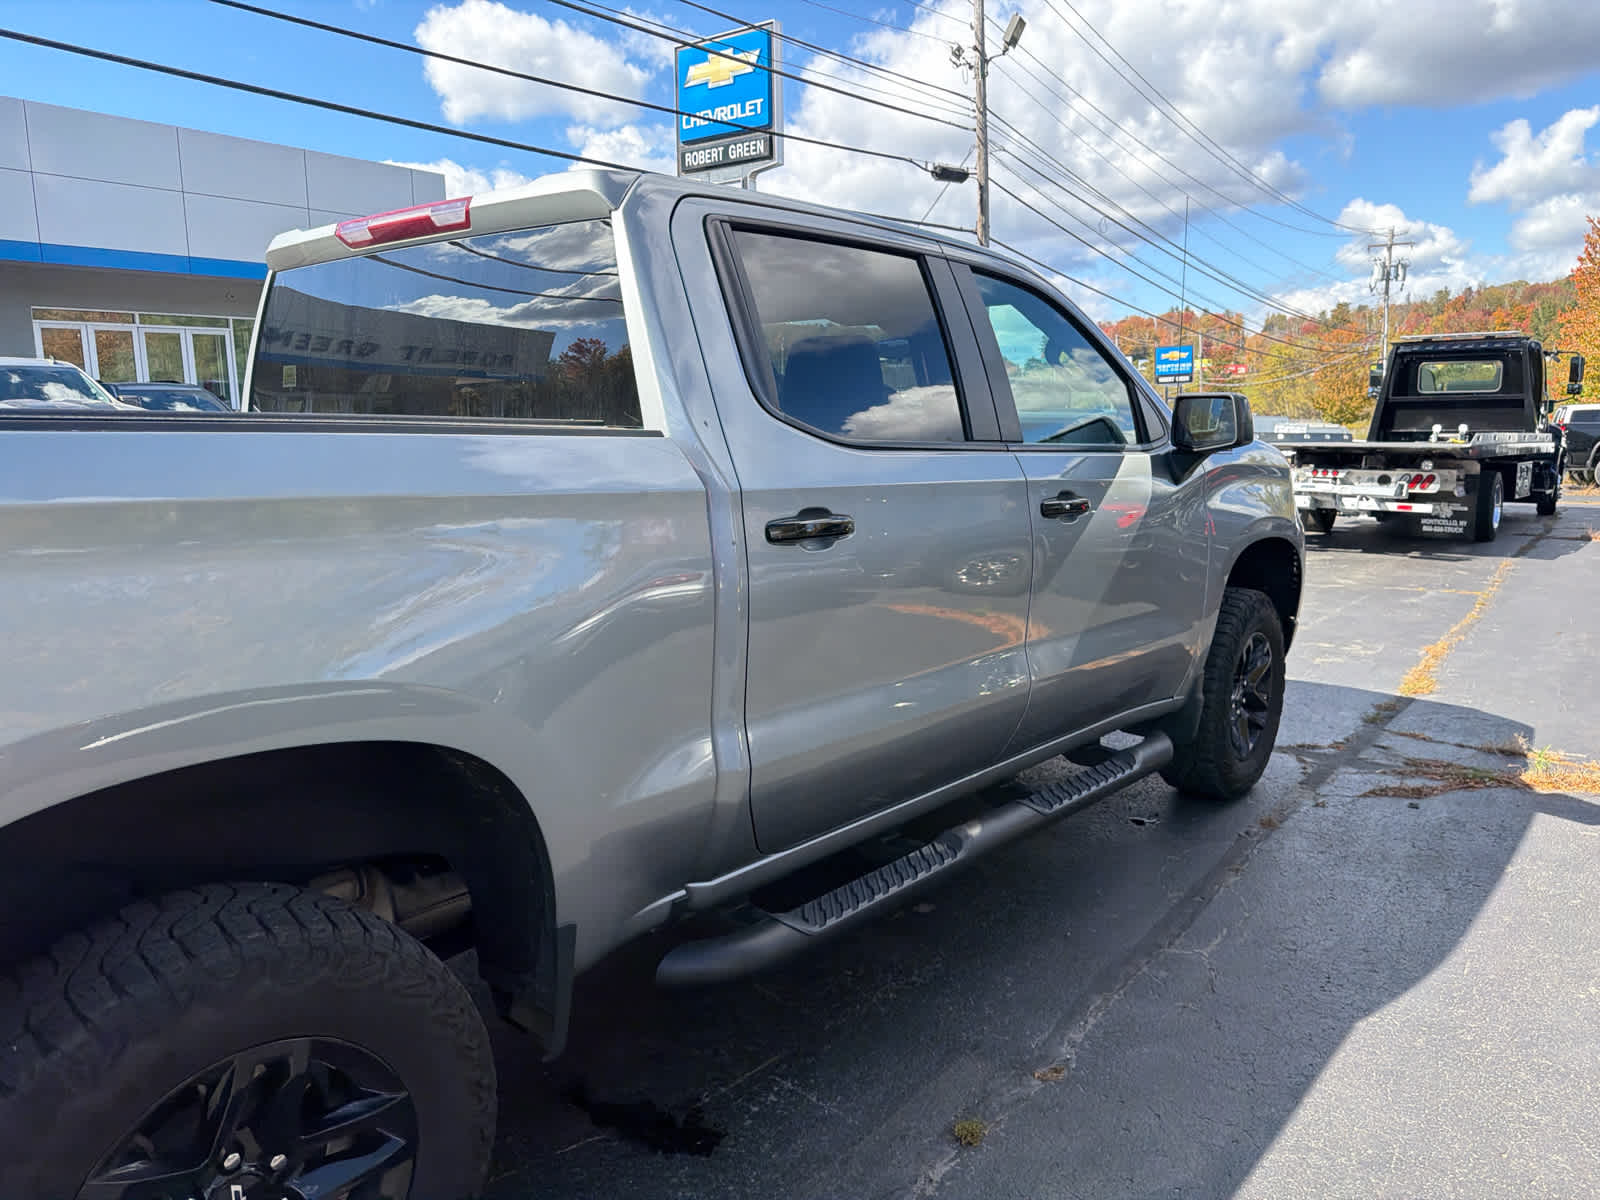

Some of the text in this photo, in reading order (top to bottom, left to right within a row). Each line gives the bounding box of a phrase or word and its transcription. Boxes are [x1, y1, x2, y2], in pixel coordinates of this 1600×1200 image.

[682, 98, 763, 129] CHEVROLET
[685, 139, 764, 167] ROBERT GREEN
